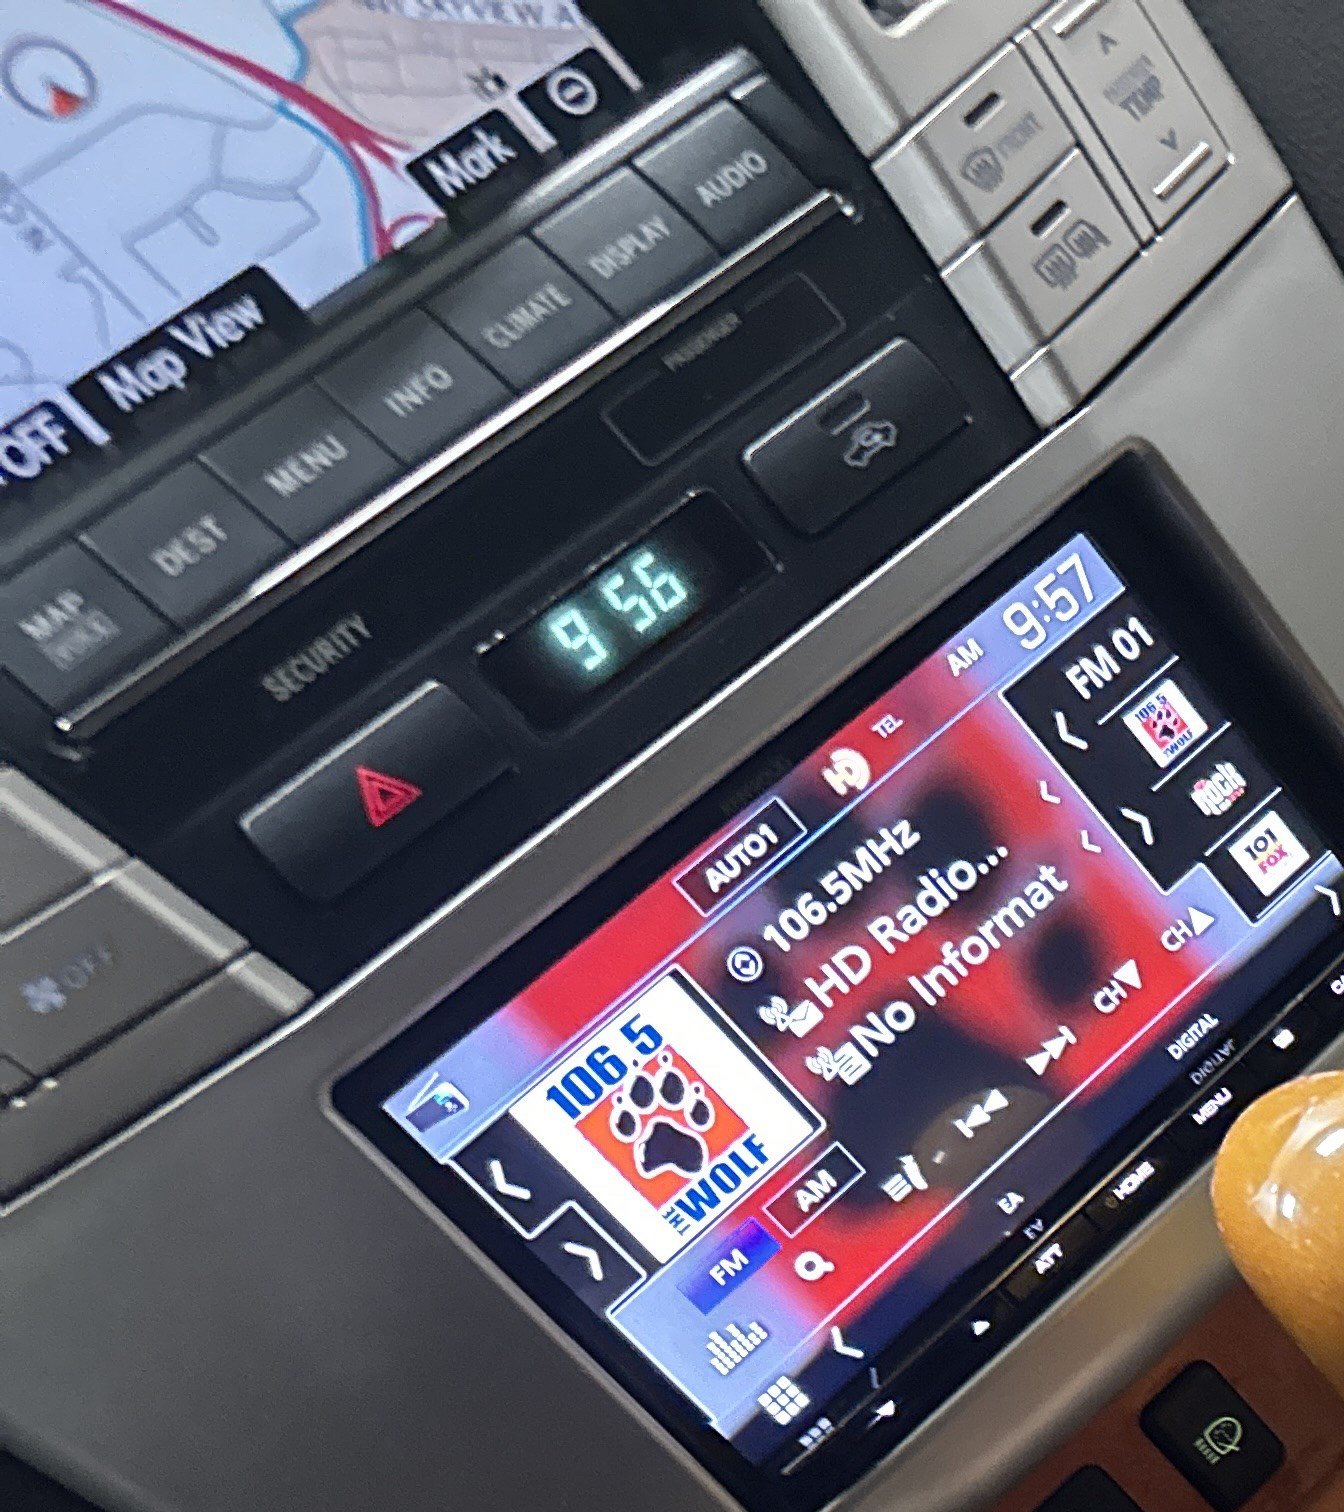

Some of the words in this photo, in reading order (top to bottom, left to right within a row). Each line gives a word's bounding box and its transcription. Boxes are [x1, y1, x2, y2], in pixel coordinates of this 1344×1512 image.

[424, 134, 518, 198] Mark
[694, 149, 769, 208] AUDIO
[587, 213, 672, 281] DISPLAY
[483, 280, 574, 350] CLIMATE
[97, 348, 188, 413] Map
[168, 293, 267, 361] View
[383, 363, 454, 419] INFO
[263, 434, 350, 498] MENU
[149, 514, 229, 577] DEST
[1001, 553, 1098, 650] 9:57
[260, 613, 374, 702] SECURITY
[946, 637, 985, 677] AM
[1065, 643, 1120, 700] FM
[1111, 616, 1155, 662] 01
[871, 714, 904, 739] TEL
[704, 823, 779, 893] AUTO1
[1244, 827, 1279, 862] 101
[1257, 844, 1289, 875] FOX
[763, 818, 922, 953] 106.5MHz
[804, 944, 872, 1008] HD
[867, 845, 1010, 953] Radio...
[848, 1000, 916, 1058] No
[908, 863, 1069, 1007] Informat
[1167, 1013, 1220, 1061] DIGITAL
[1191, 1087, 1233, 1125] MENU
[676, 1133, 771, 1224] WOLF
[794, 1169, 839, 1212] AM
[1112, 1161, 1155, 1201] HOME
[709, 1249, 751, 1287] FM
[1034, 1243, 1064, 1275] ATT
